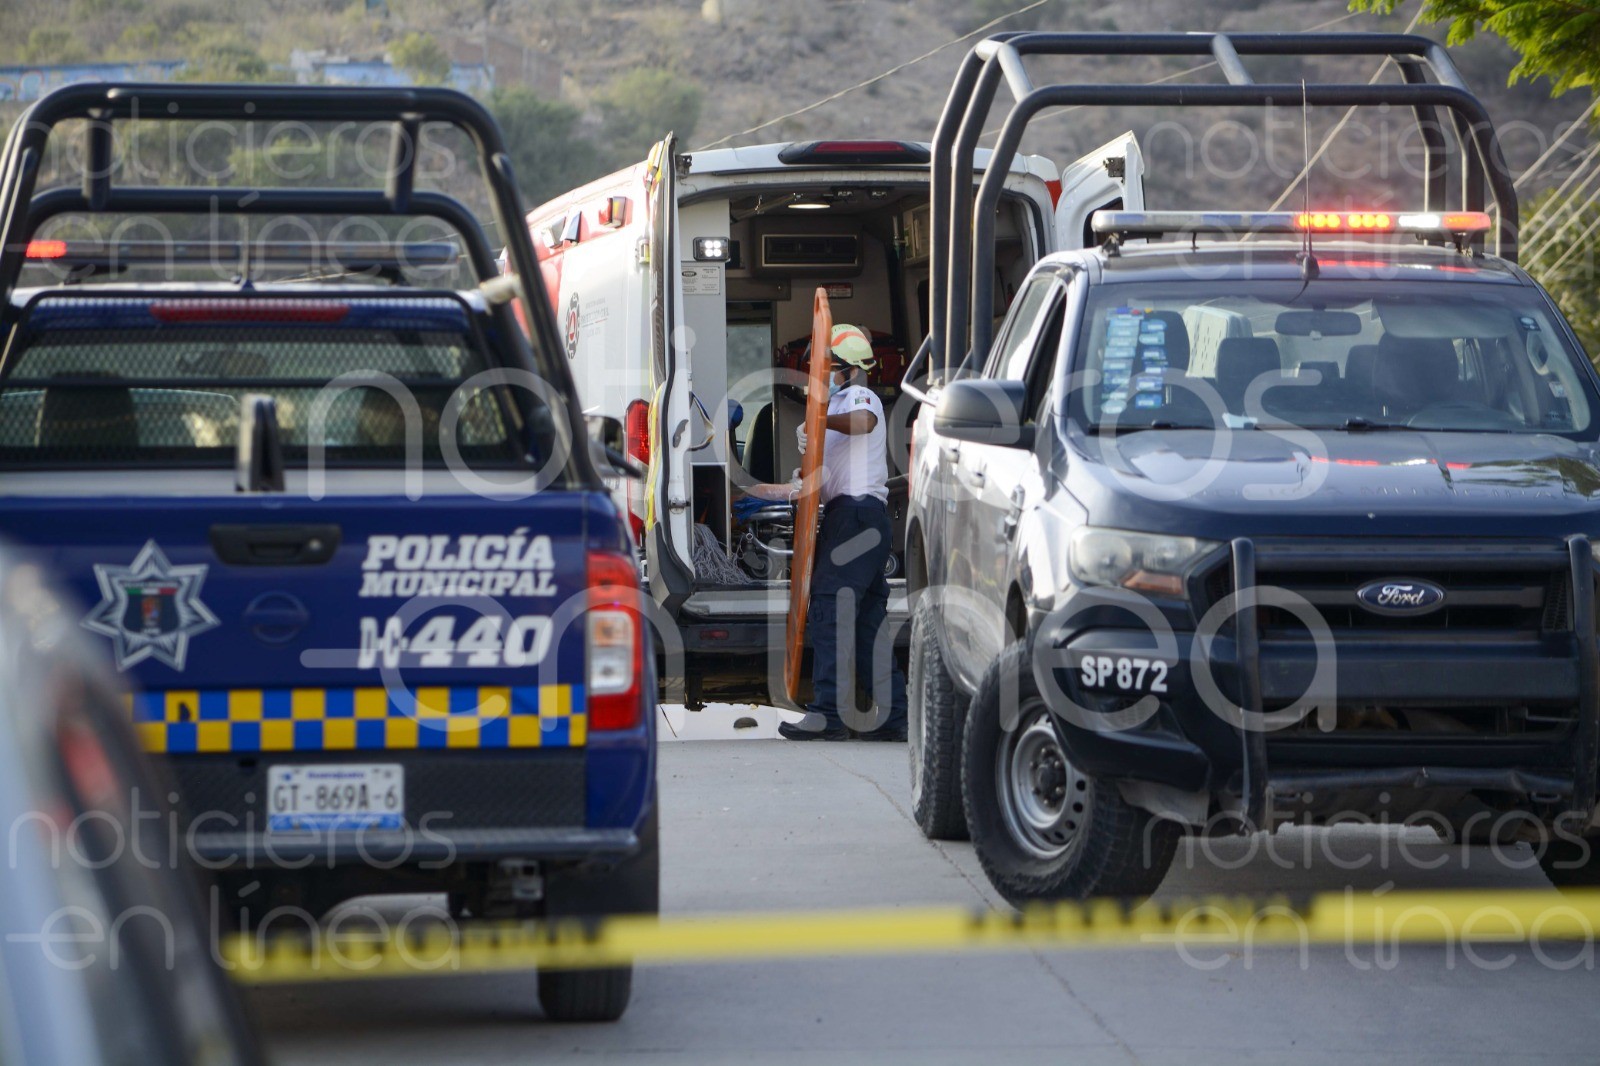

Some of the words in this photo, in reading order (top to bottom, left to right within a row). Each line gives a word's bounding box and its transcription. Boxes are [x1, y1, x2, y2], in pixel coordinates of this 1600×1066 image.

[361, 526, 556, 571] POLICÍA
[358, 571, 557, 597] MUNICIPAL
[1377, 584, 1425, 605] Ford
